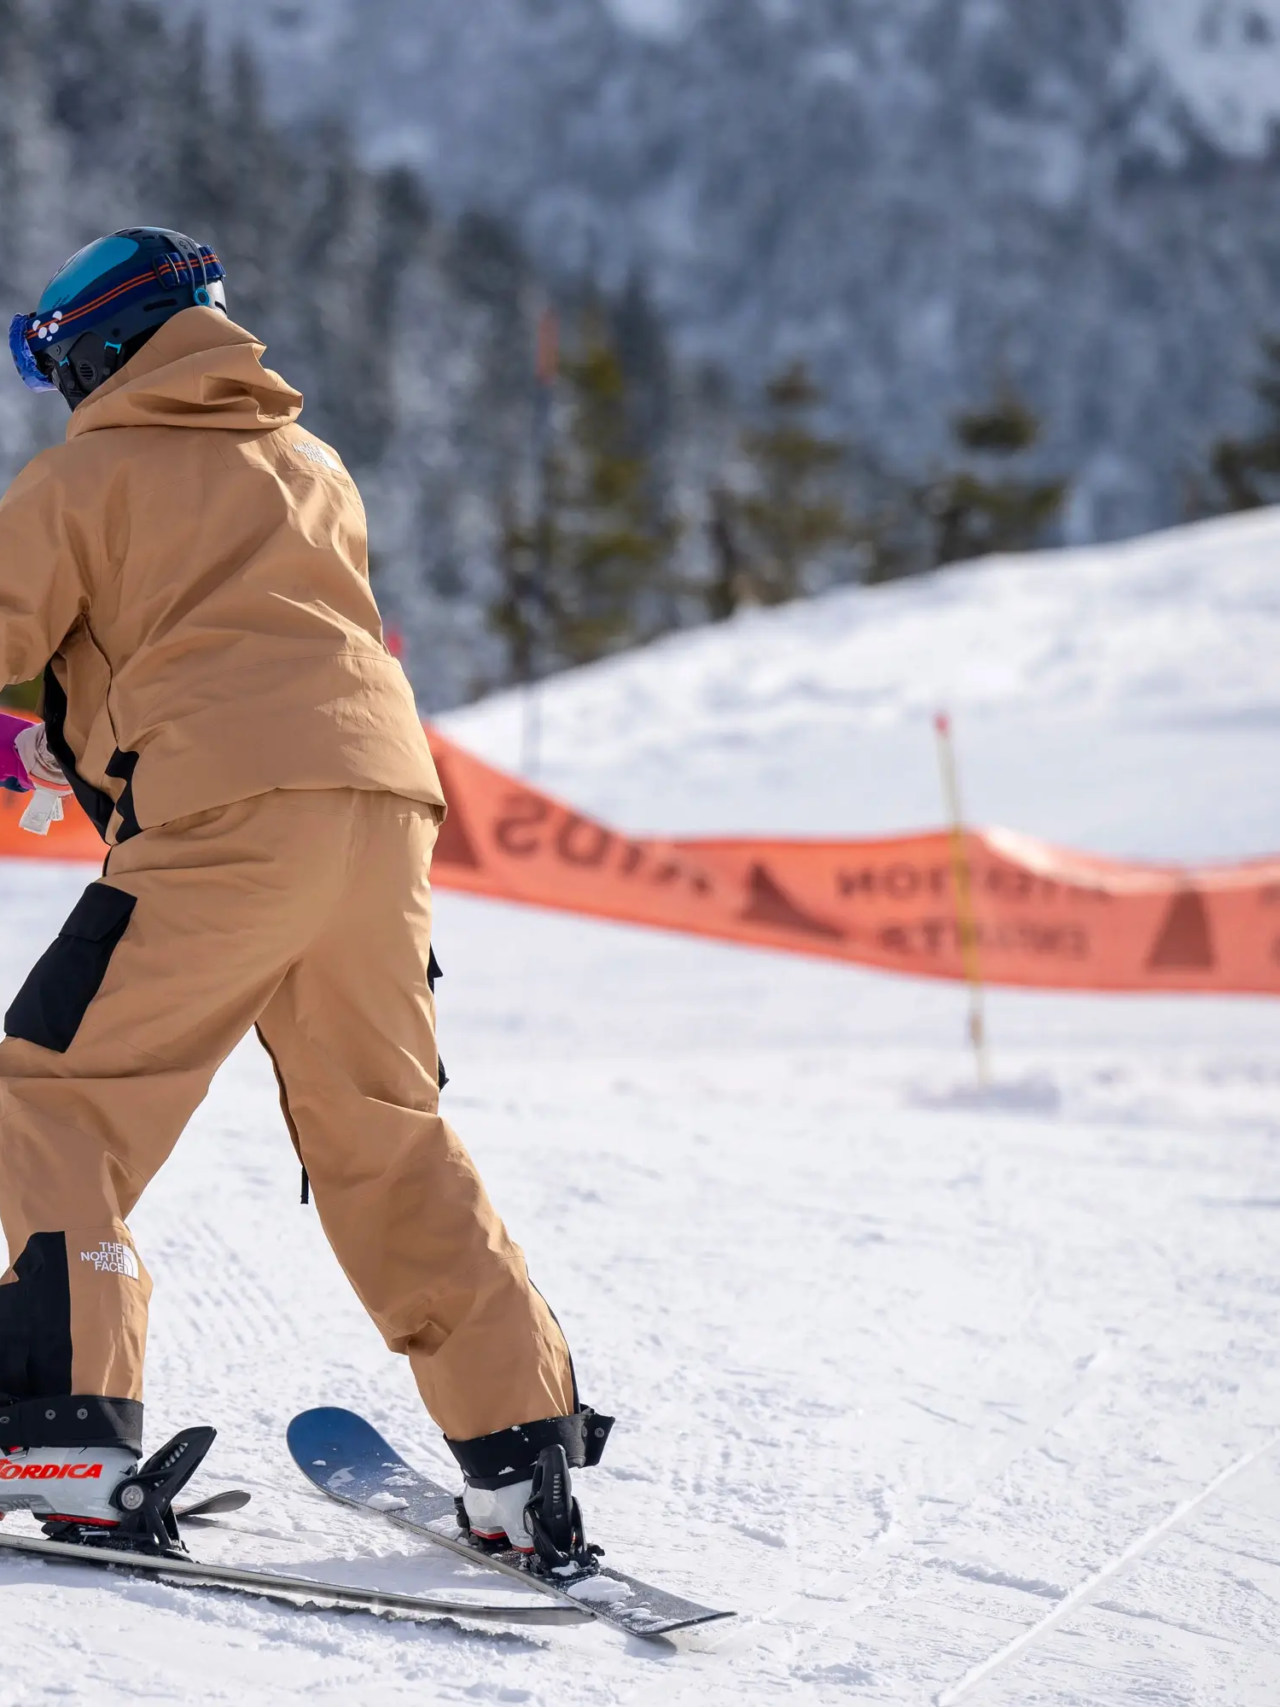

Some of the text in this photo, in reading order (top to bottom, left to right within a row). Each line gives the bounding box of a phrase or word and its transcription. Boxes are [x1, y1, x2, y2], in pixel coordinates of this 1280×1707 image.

[99, 1241, 123, 1254] THE
[80, 1251, 124, 1265] NORTH
[94, 1260, 124, 1274] FACE
